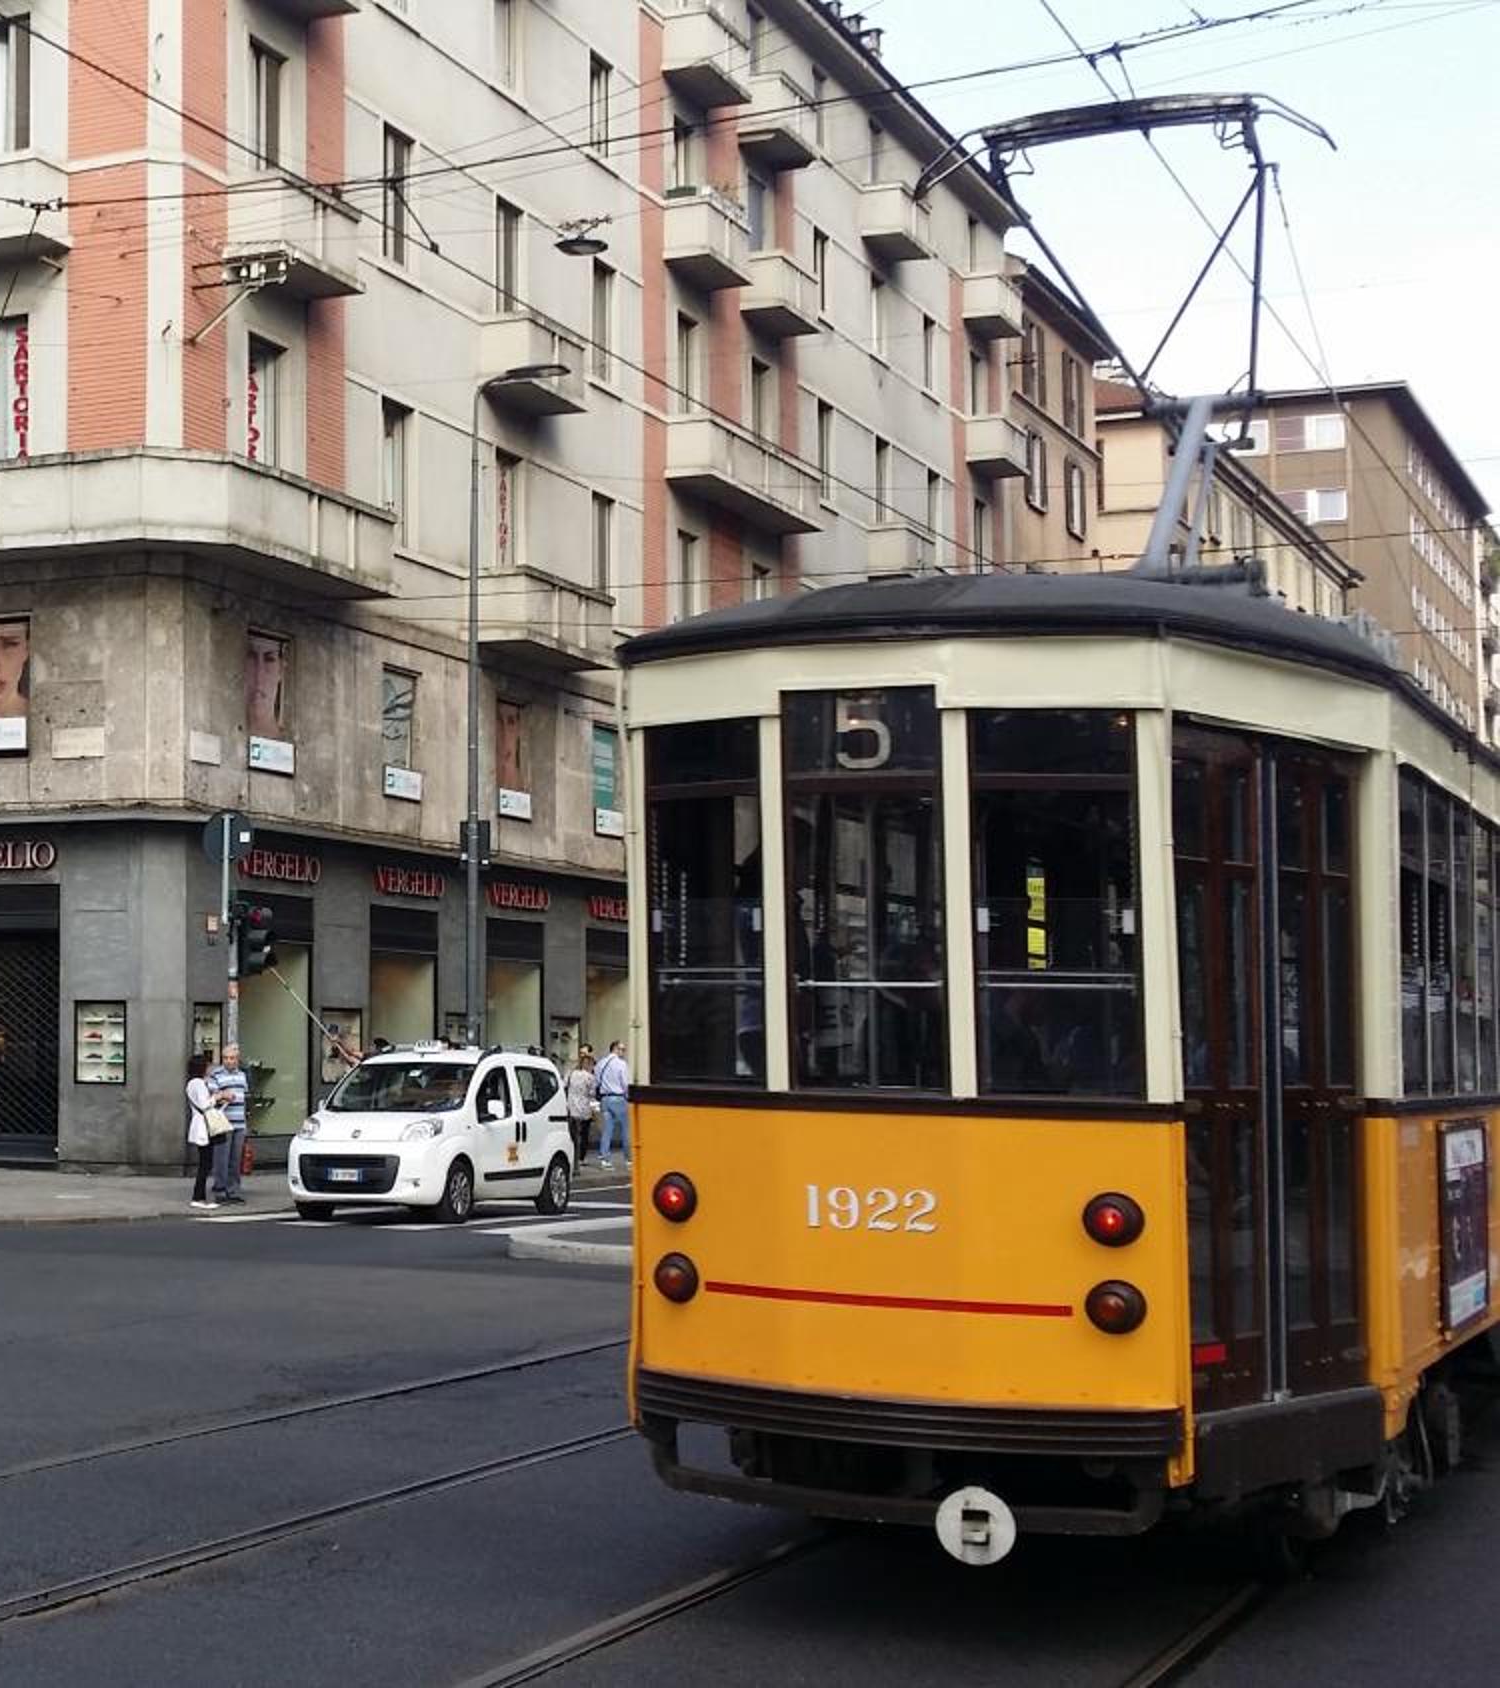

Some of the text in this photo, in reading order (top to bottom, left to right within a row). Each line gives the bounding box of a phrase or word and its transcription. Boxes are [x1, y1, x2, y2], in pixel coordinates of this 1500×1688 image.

[835, 692, 891, 769] 5
[237, 849, 321, 883] VERGELIO
[376, 865, 445, 897] VERGELIO
[806, 1184, 937, 1232] 1922
